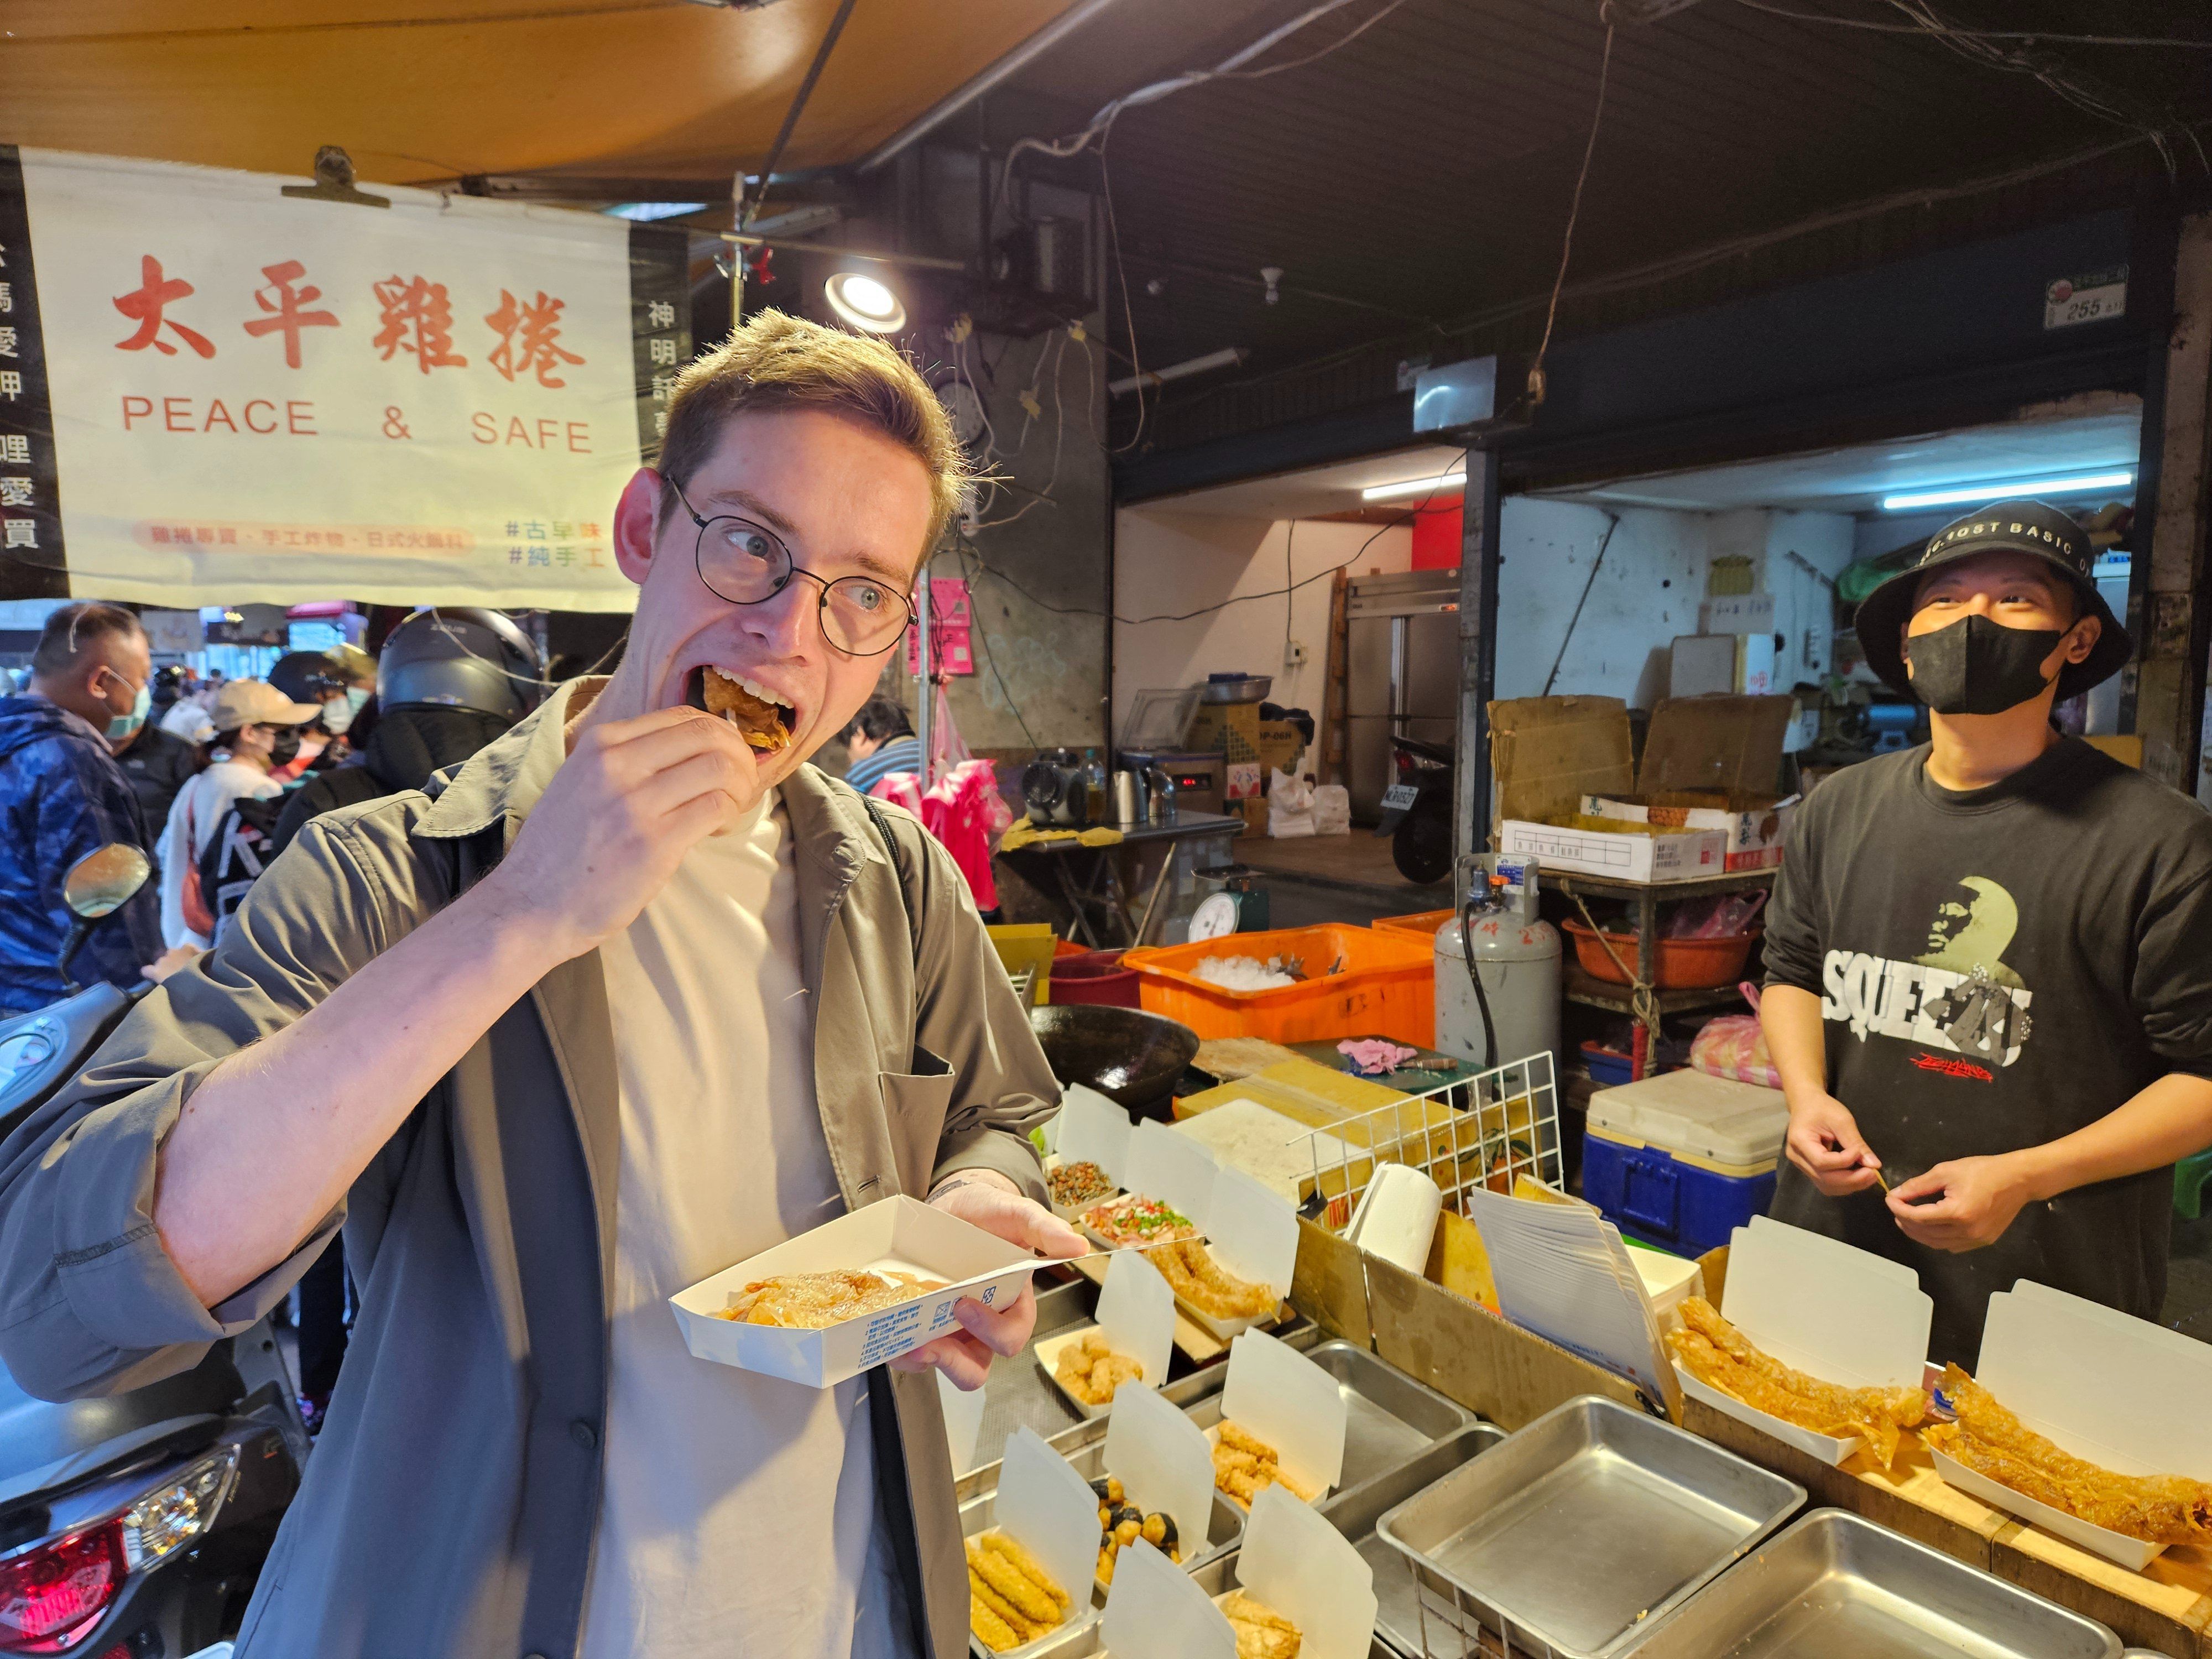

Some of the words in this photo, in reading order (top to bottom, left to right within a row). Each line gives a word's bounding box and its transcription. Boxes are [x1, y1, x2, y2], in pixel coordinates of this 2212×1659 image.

[113, 254, 586, 388] 太平雞捲
[122, 396, 319, 436] PEACE
[382, 406, 413, 440] &
[472, 413, 593, 454] SAFE
[2010, 523, 2071, 555] BASIC
